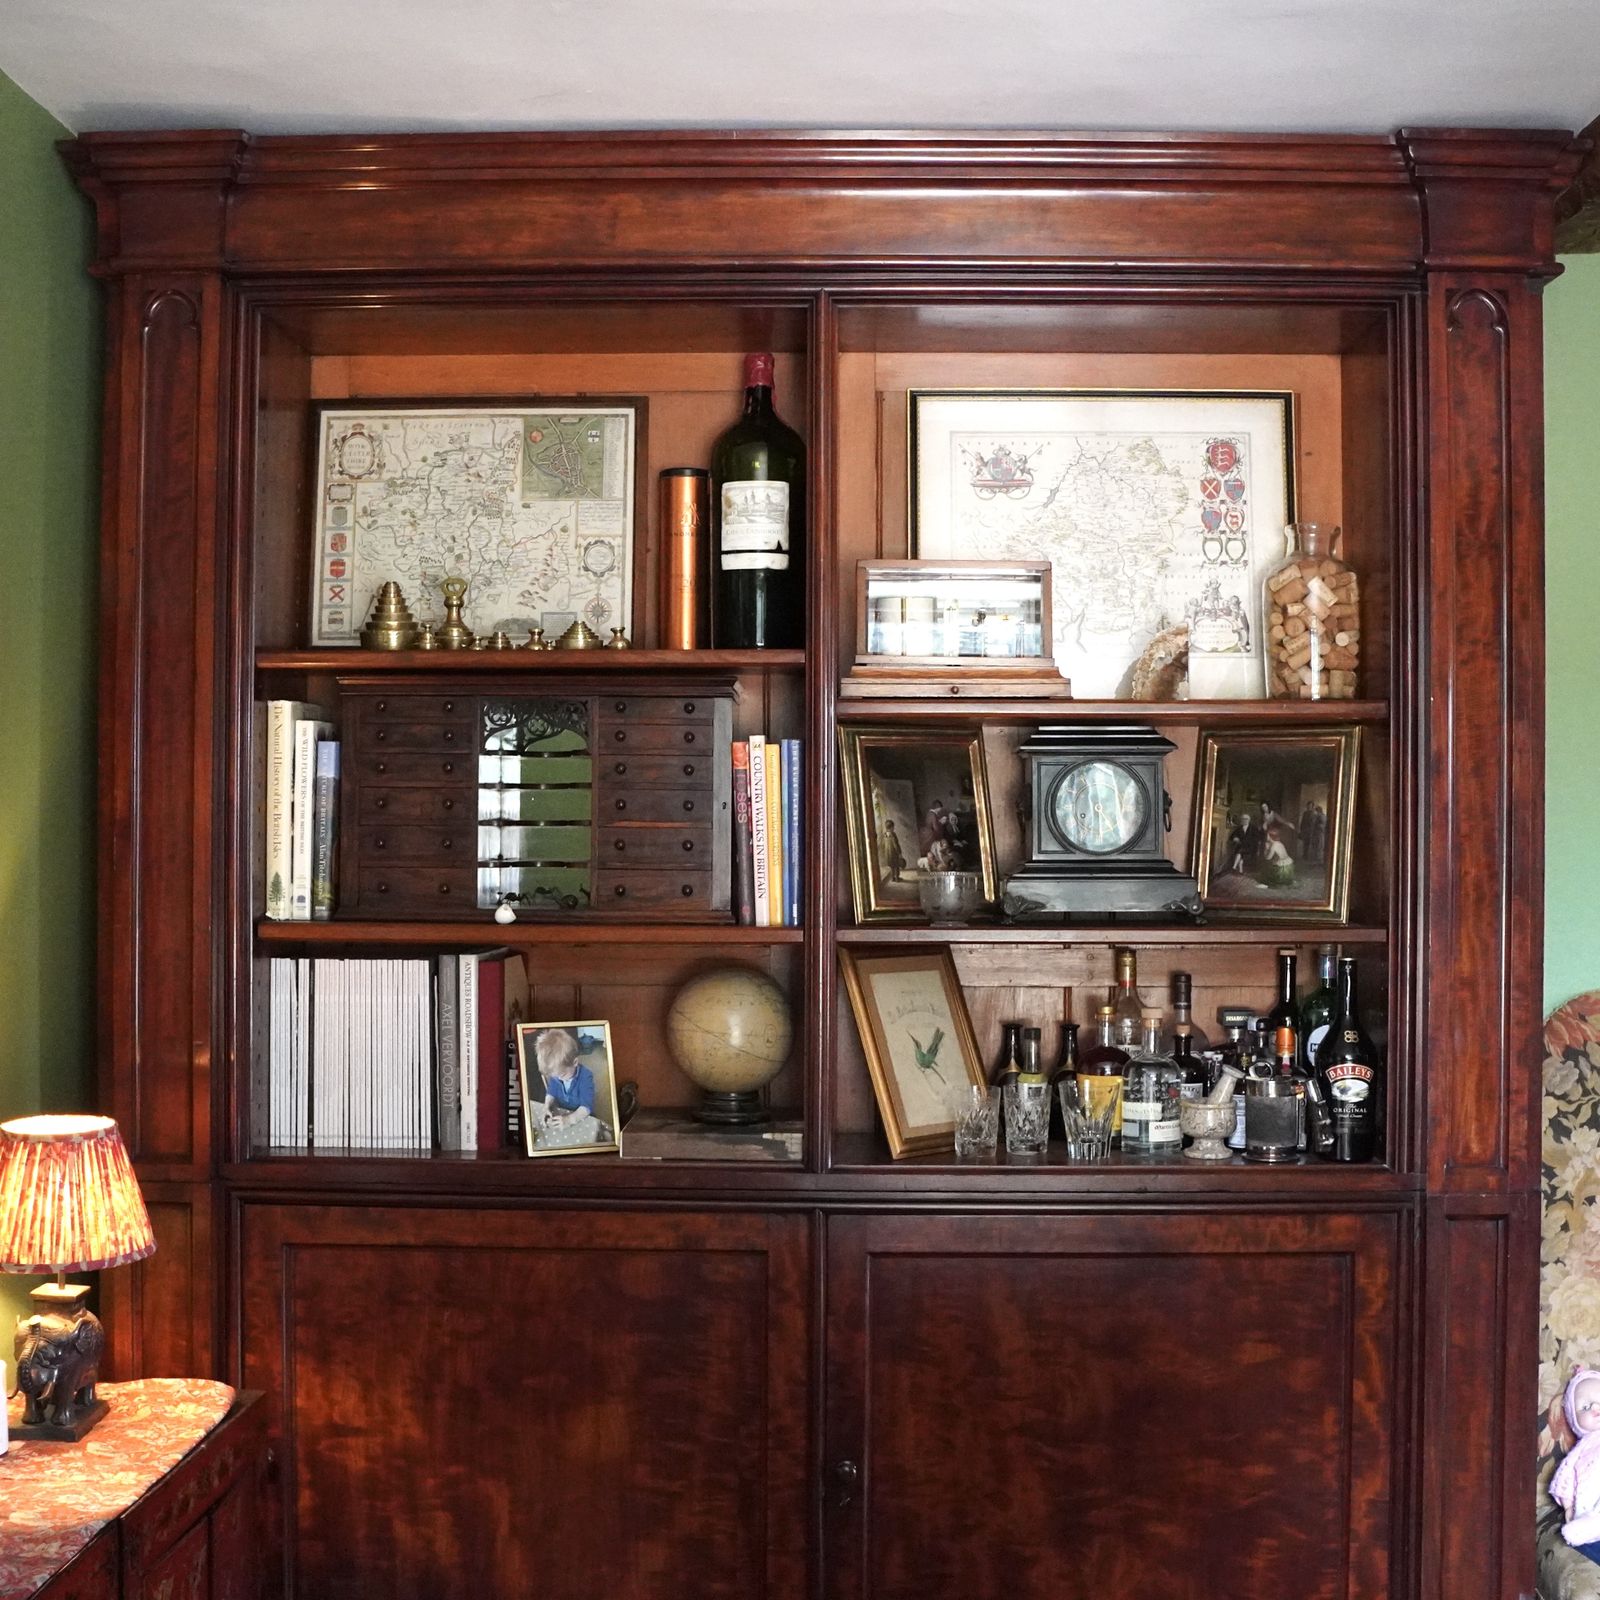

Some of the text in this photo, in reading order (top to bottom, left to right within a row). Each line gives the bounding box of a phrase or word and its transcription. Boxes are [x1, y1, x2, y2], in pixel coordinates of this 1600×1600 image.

[301, 738, 309, 761] WILD
[271, 705, 283, 860] The Natural History of the British Isles
[300, 762, 309, 800] FLOWERS
[736, 773, 748, 824] roses
[753, 755, 767, 900] COUNTRY WALKS IN BRITAIN
[318, 841, 327, 859] Alan
[317, 859, 327, 901] Titchmarsh
[463, 961, 473, 997] ANTIQUES
[441, 1003, 454, 1031] AXEL
[464, 998, 473, 1039] ROADSHOW
[441, 1036, 454, 1109] VERVOORDT
[1328, 1066, 1372, 1079] BAILEYS
